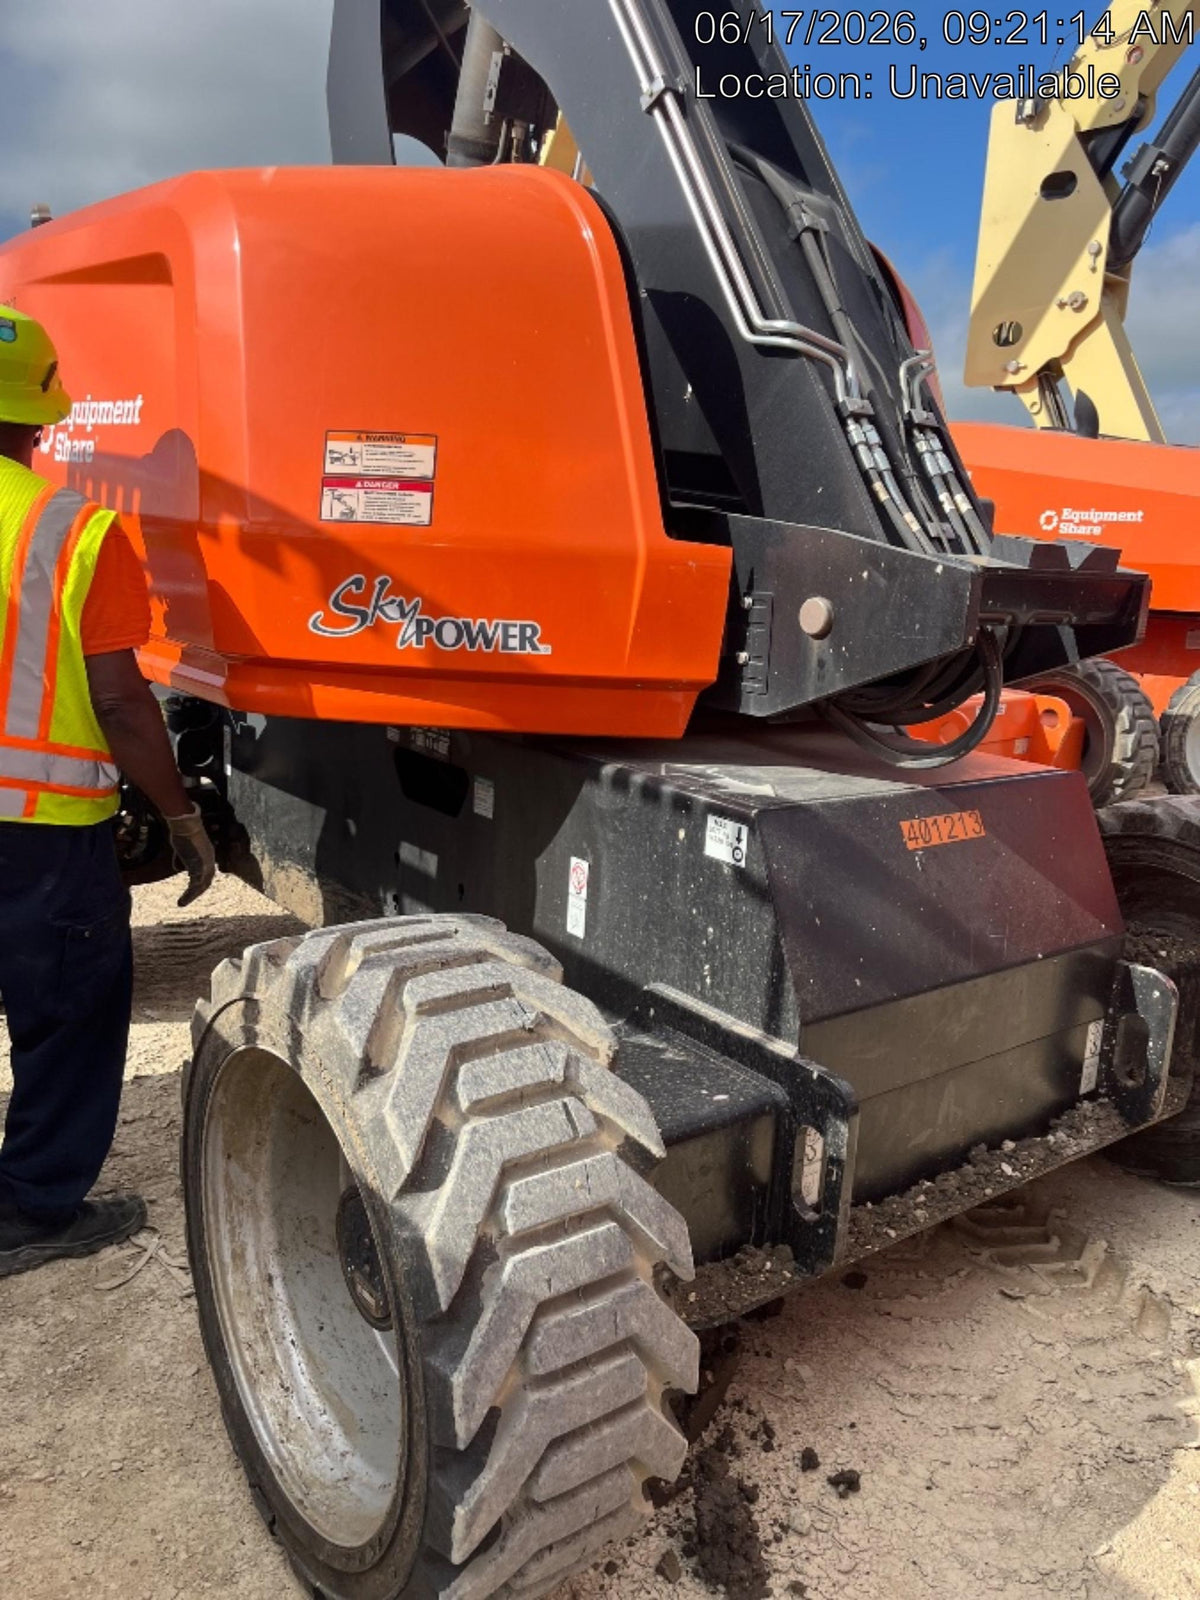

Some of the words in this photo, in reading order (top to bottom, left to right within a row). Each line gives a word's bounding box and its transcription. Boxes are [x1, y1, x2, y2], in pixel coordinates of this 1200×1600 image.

[59, 394, 143, 432] quipment
[54, 431, 95, 463] Share
[363, 481, 399, 490] DANGER
[1061, 507, 1144, 523] Equipment
[1059, 522, 1102, 536] Share
[906, 812, 983, 846] 401213
